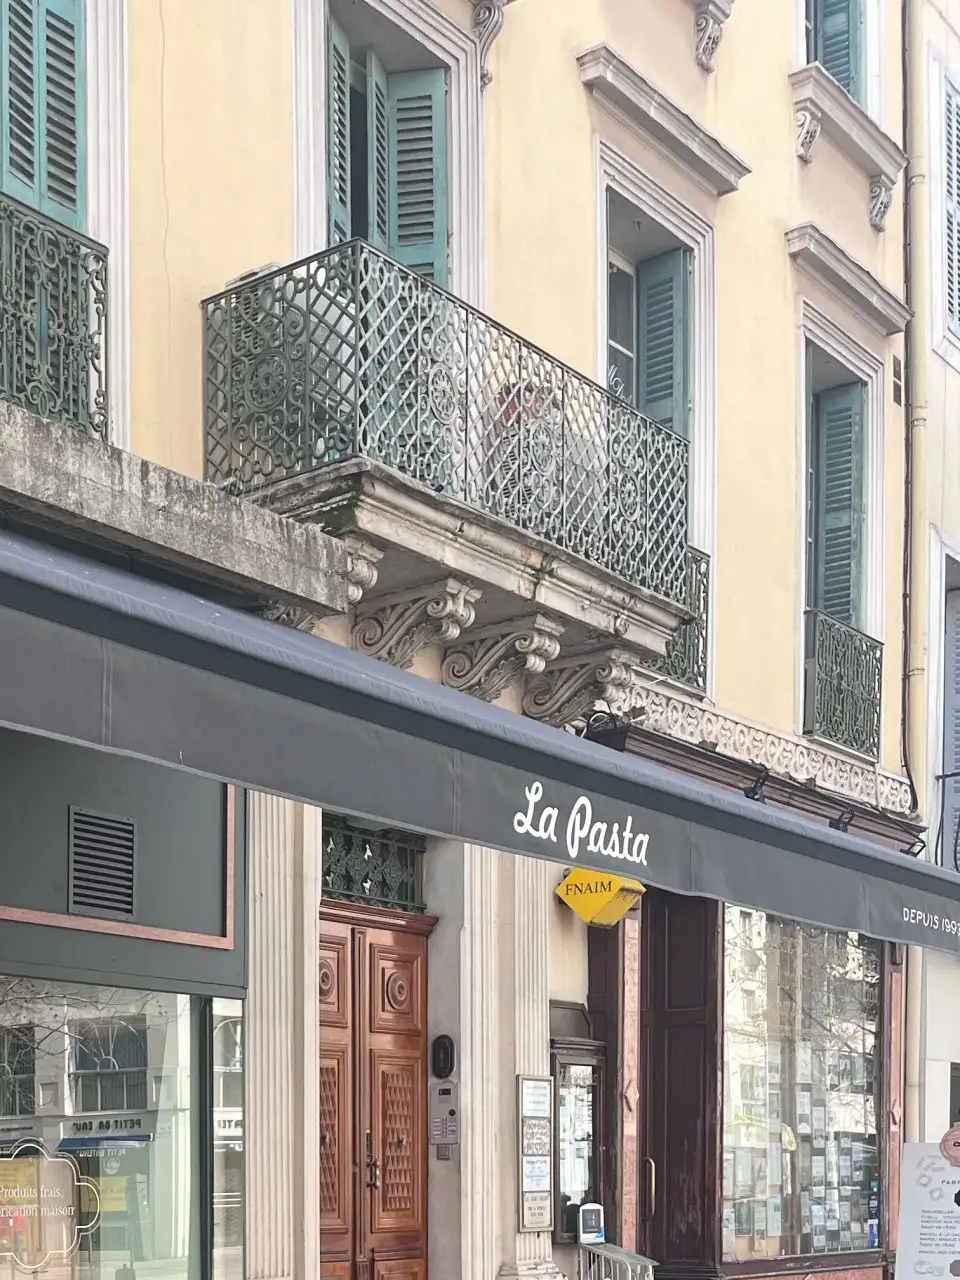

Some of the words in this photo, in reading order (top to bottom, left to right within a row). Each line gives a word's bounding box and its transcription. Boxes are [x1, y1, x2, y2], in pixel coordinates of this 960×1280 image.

[513, 781, 558, 844] La
[566, 796, 650, 866] Pasta
[565, 880, 613, 897] FNAIM
[903, 907, 939, 930] DEPUIS
[40, 1184, 64, 1199] frais,
[41, 1205, 76, 1217] maison
